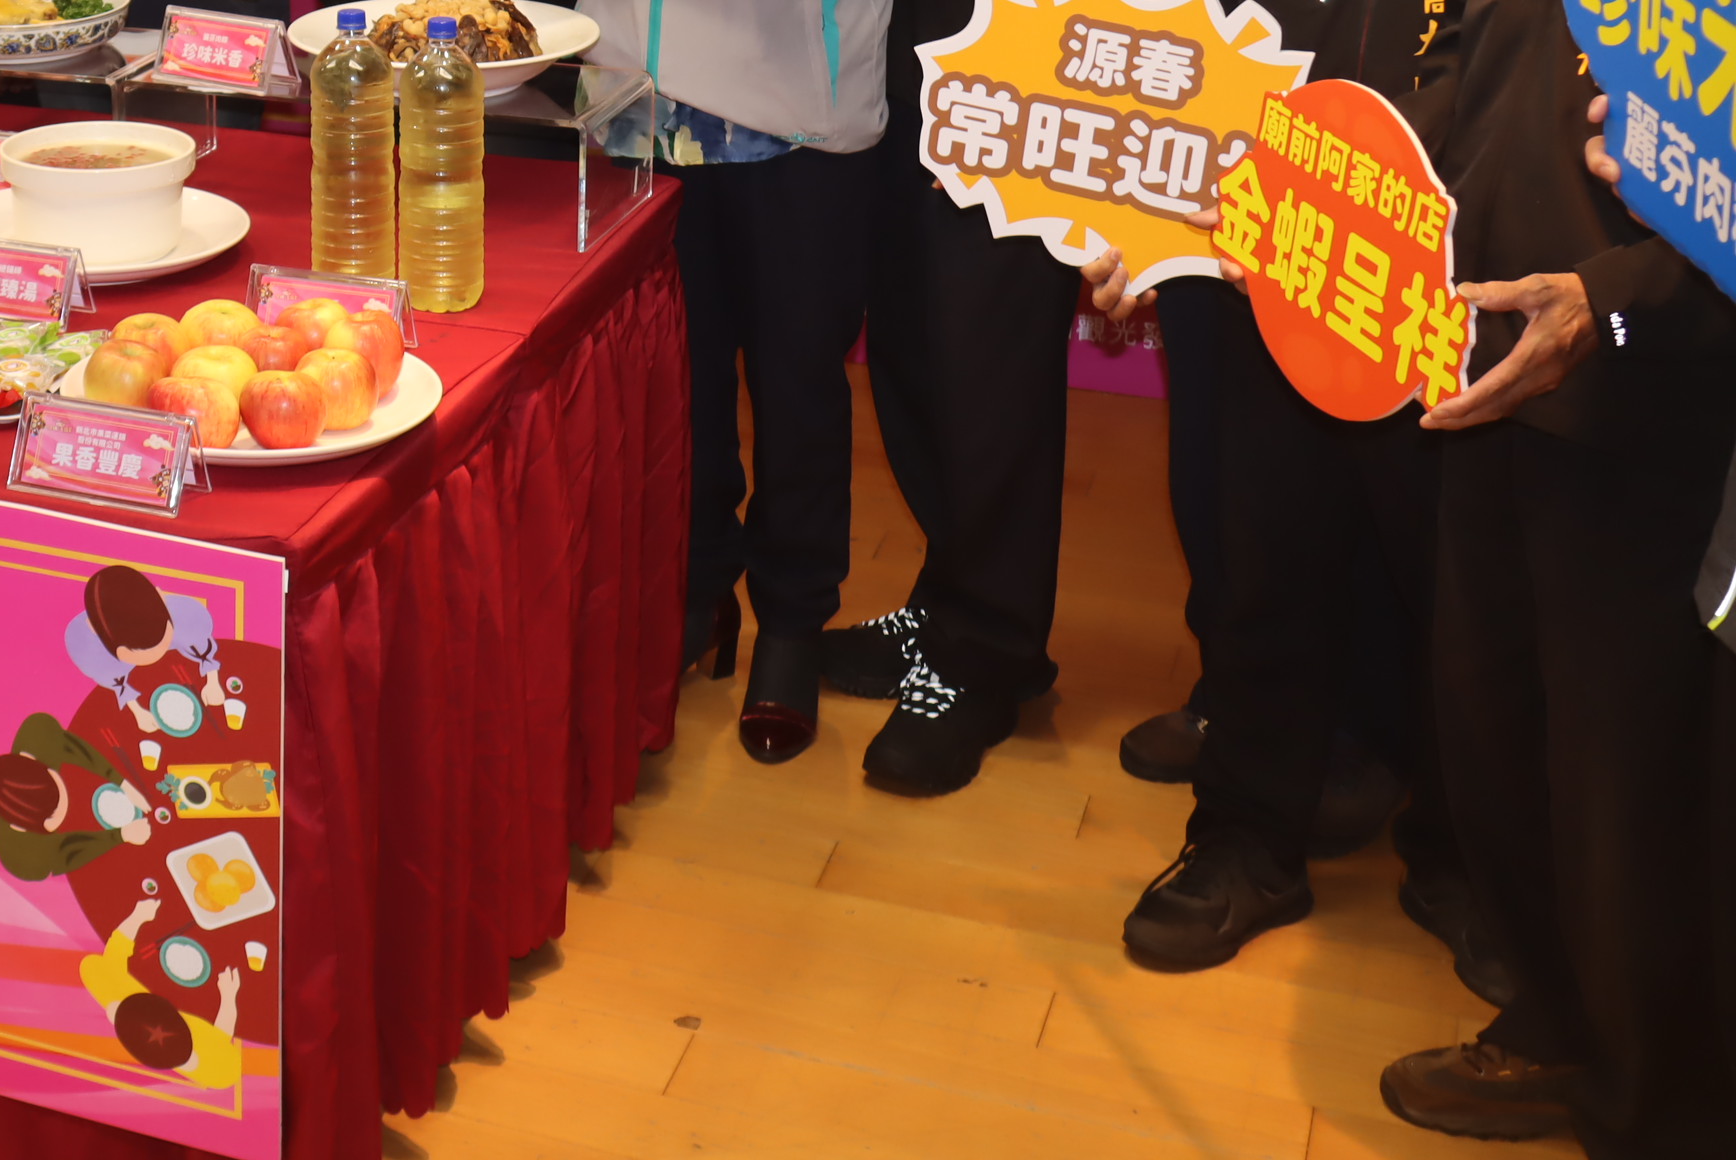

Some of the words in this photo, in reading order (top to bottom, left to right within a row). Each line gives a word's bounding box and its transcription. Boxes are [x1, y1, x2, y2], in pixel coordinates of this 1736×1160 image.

[181, 43, 244, 69] 珍味米香
[1064, 22, 1195, 101] 源春
[1260, 97, 1446, 252] 廟前阿家的店
[1624, 90, 1736, 247] 麗芬肉
[1212, 158, 1466, 407] 金蝦呈祥
[50, 441, 143, 480] 果香豐慶
